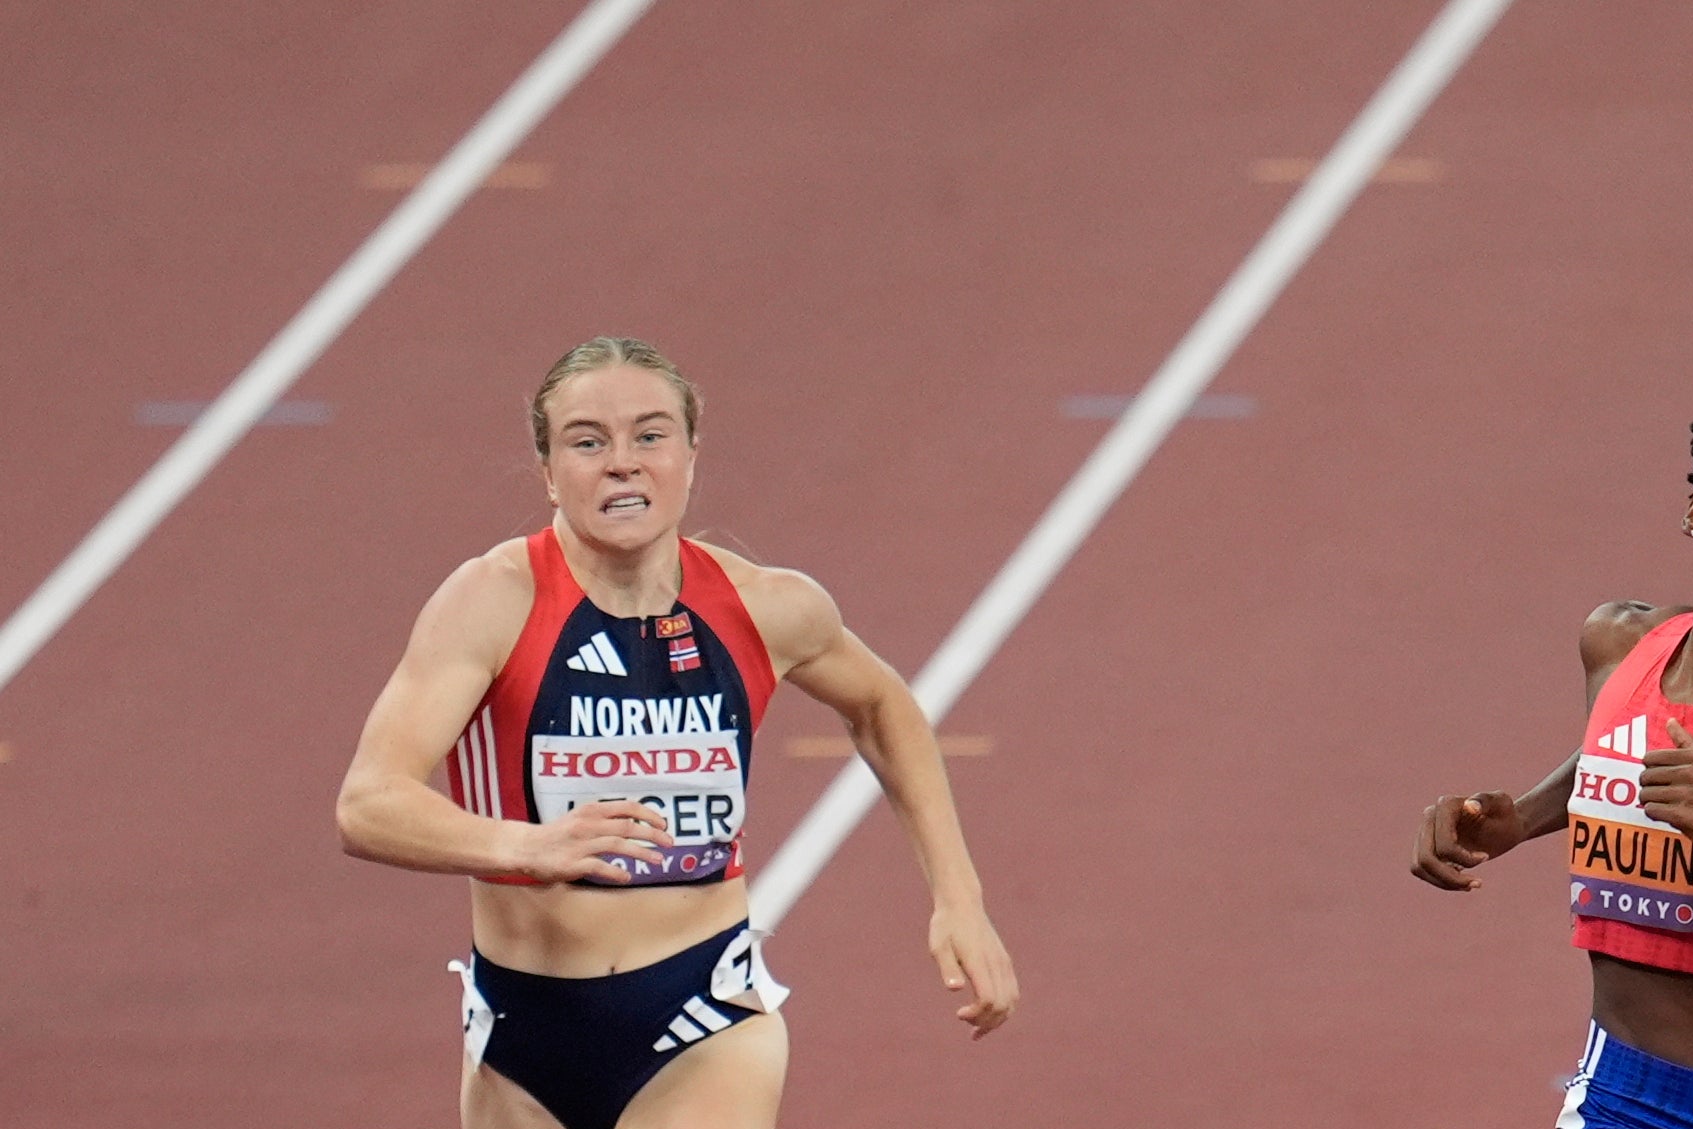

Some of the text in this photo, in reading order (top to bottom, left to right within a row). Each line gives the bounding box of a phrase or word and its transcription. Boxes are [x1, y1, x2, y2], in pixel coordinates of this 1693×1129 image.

[569, 693, 724, 737] NORWAY
[537, 746, 738, 779] HONDA
[567, 794, 734, 837] GER
